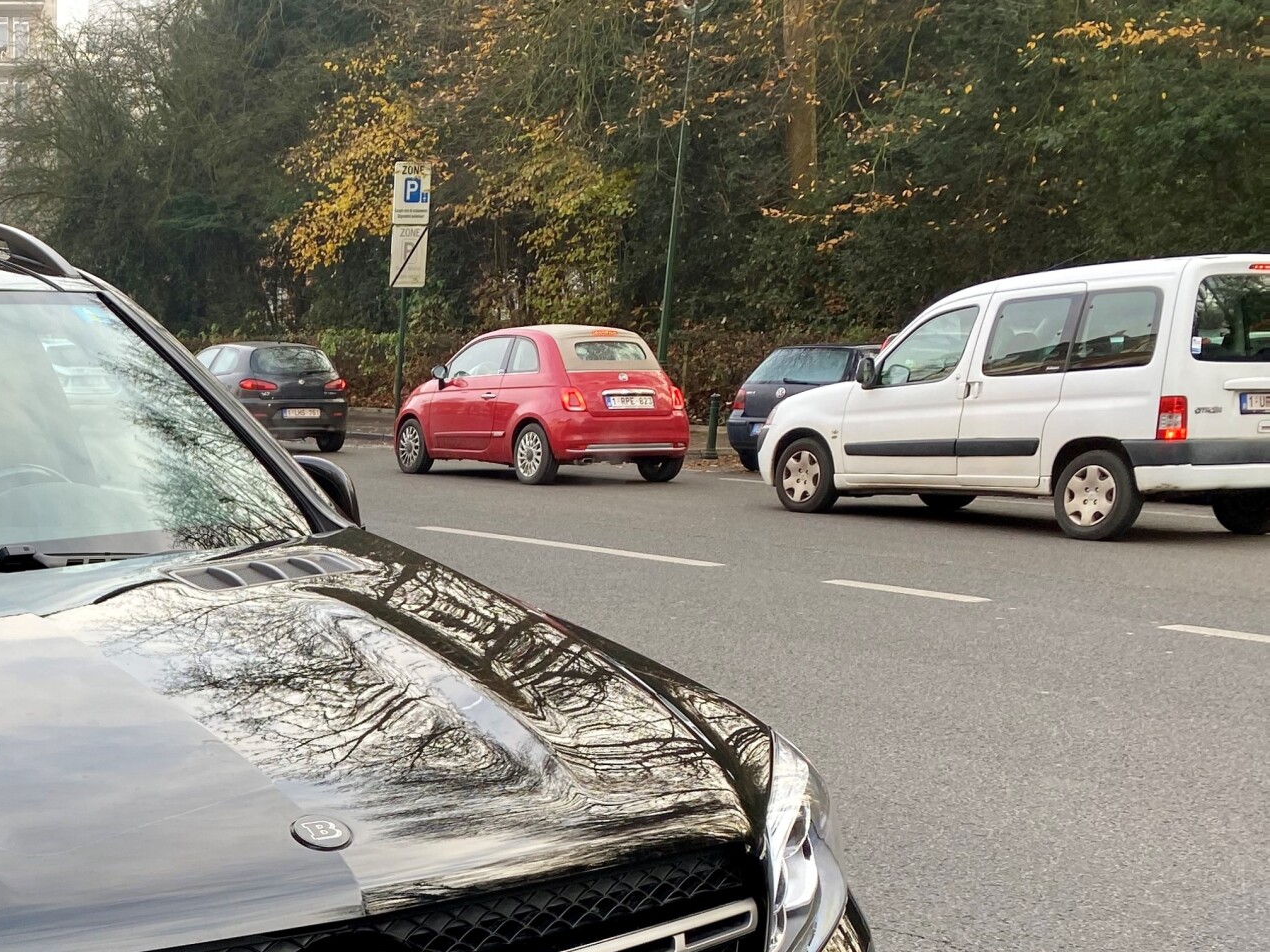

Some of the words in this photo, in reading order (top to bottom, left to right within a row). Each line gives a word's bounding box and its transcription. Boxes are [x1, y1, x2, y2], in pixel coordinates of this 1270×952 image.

[402, 165, 425, 175] ZONE
[406, 180, 419, 201] P
[400, 228, 421, 238] ZONE
[301, 821, 342, 841] B
